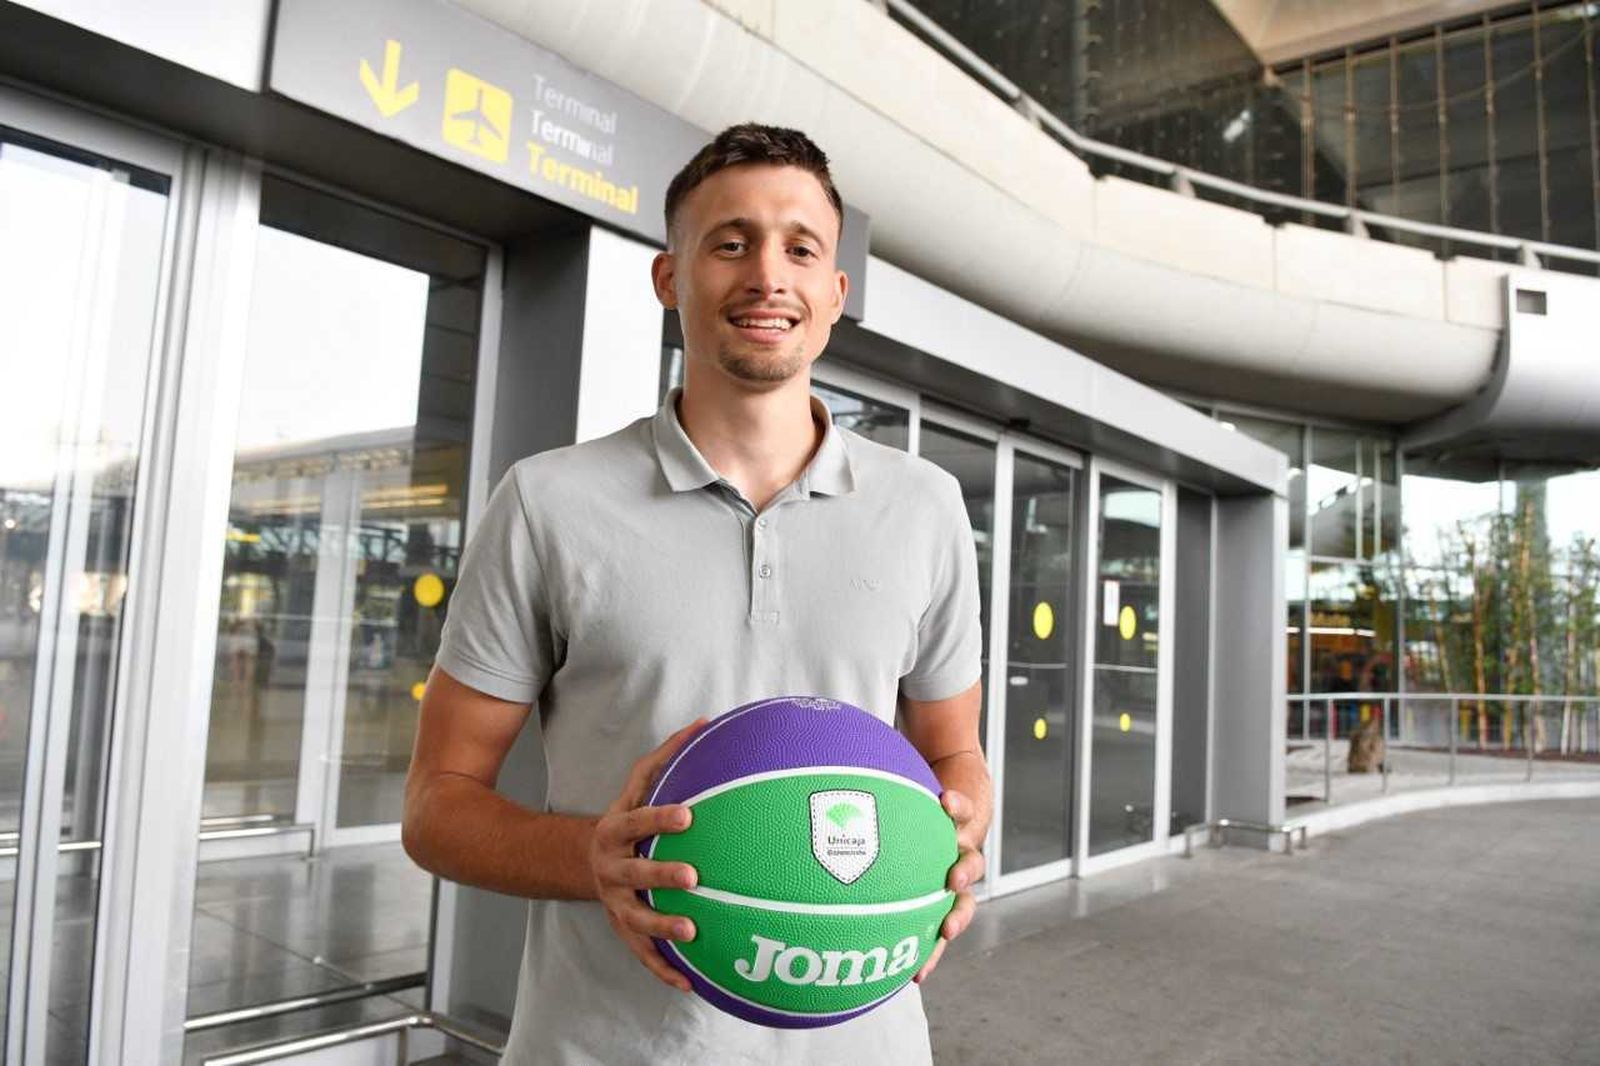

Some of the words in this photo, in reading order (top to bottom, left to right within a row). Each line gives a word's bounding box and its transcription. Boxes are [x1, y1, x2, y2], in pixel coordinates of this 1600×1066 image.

[533, 73, 617, 134] Terminal
[530, 109, 613, 166] Terminal
[527, 139, 639, 215] Terminal
[827, 833, 866, 847] Unicaja
[734, 934, 920, 986] Joma
